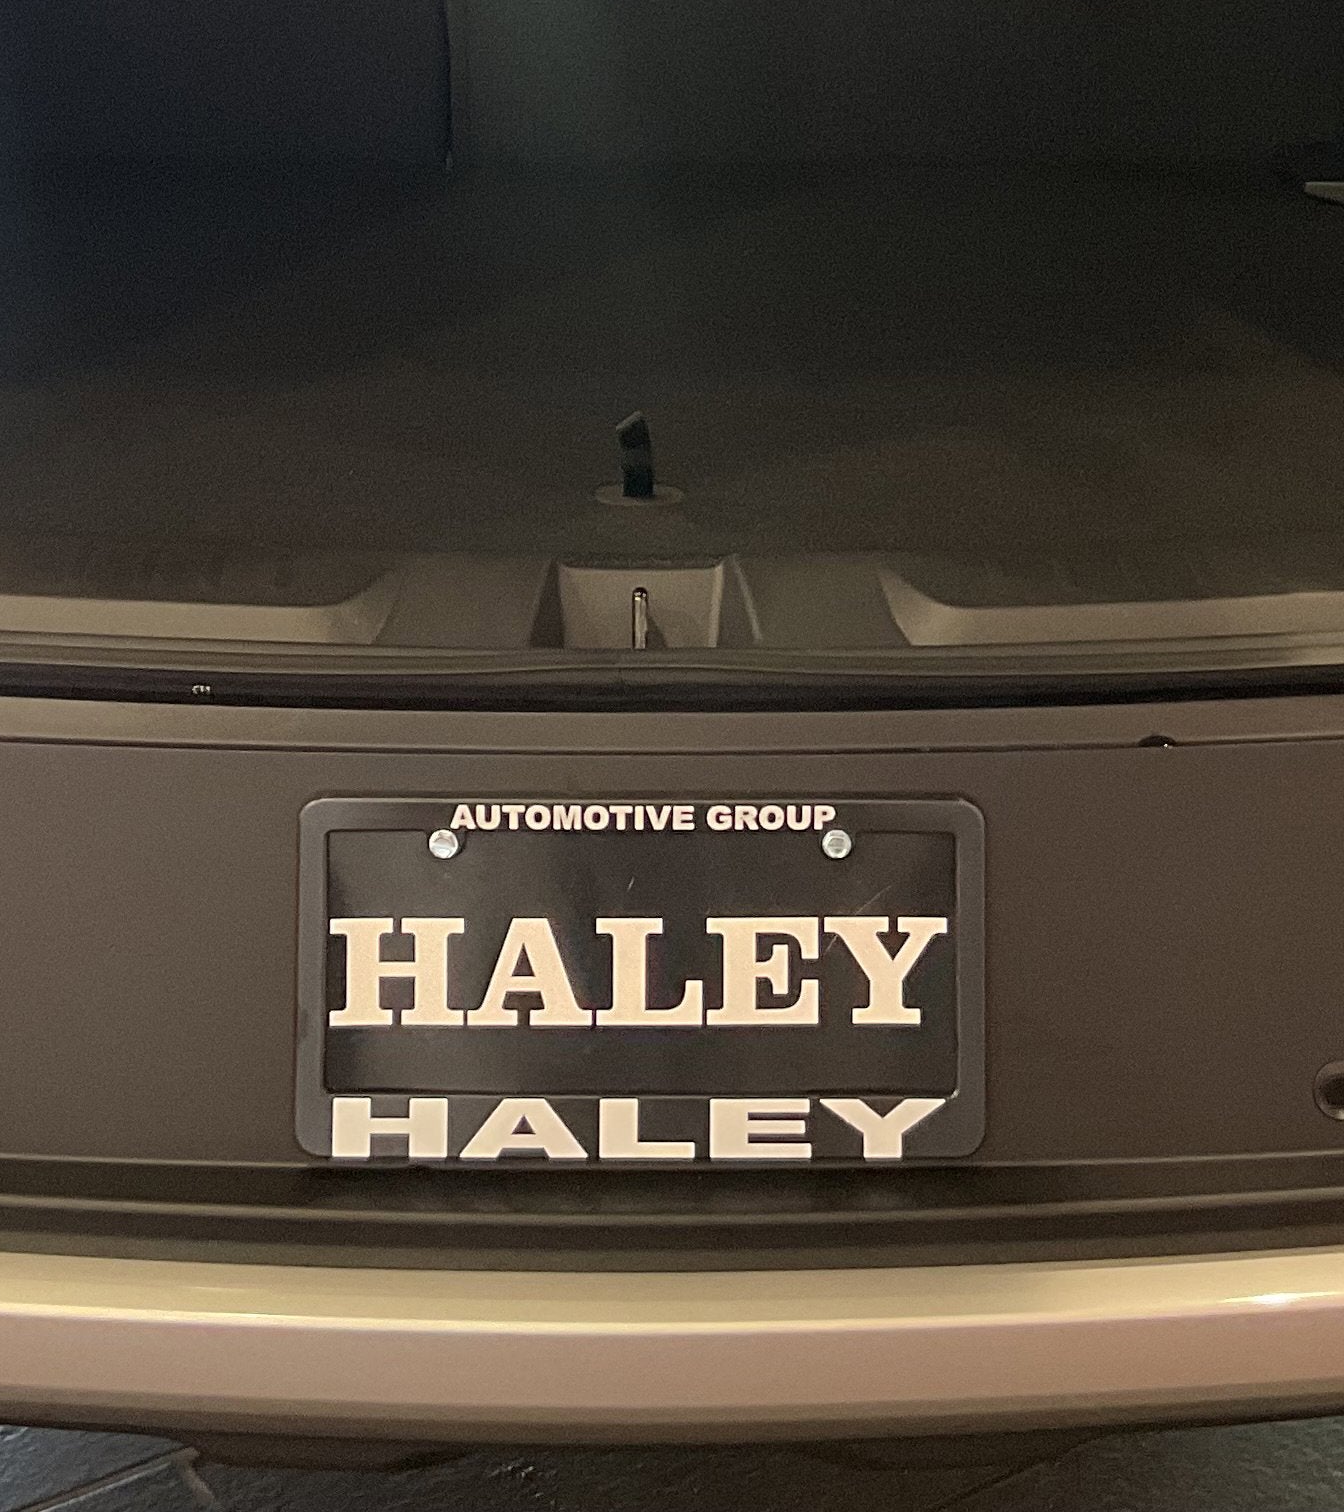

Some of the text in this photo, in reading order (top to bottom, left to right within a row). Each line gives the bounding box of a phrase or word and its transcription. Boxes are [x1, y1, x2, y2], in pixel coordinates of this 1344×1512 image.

[449, 803, 836, 831] AUTOMOTIVE GROUP
[329, 917, 948, 1026] HALEY
[331, 1096, 947, 1159] HALEY
